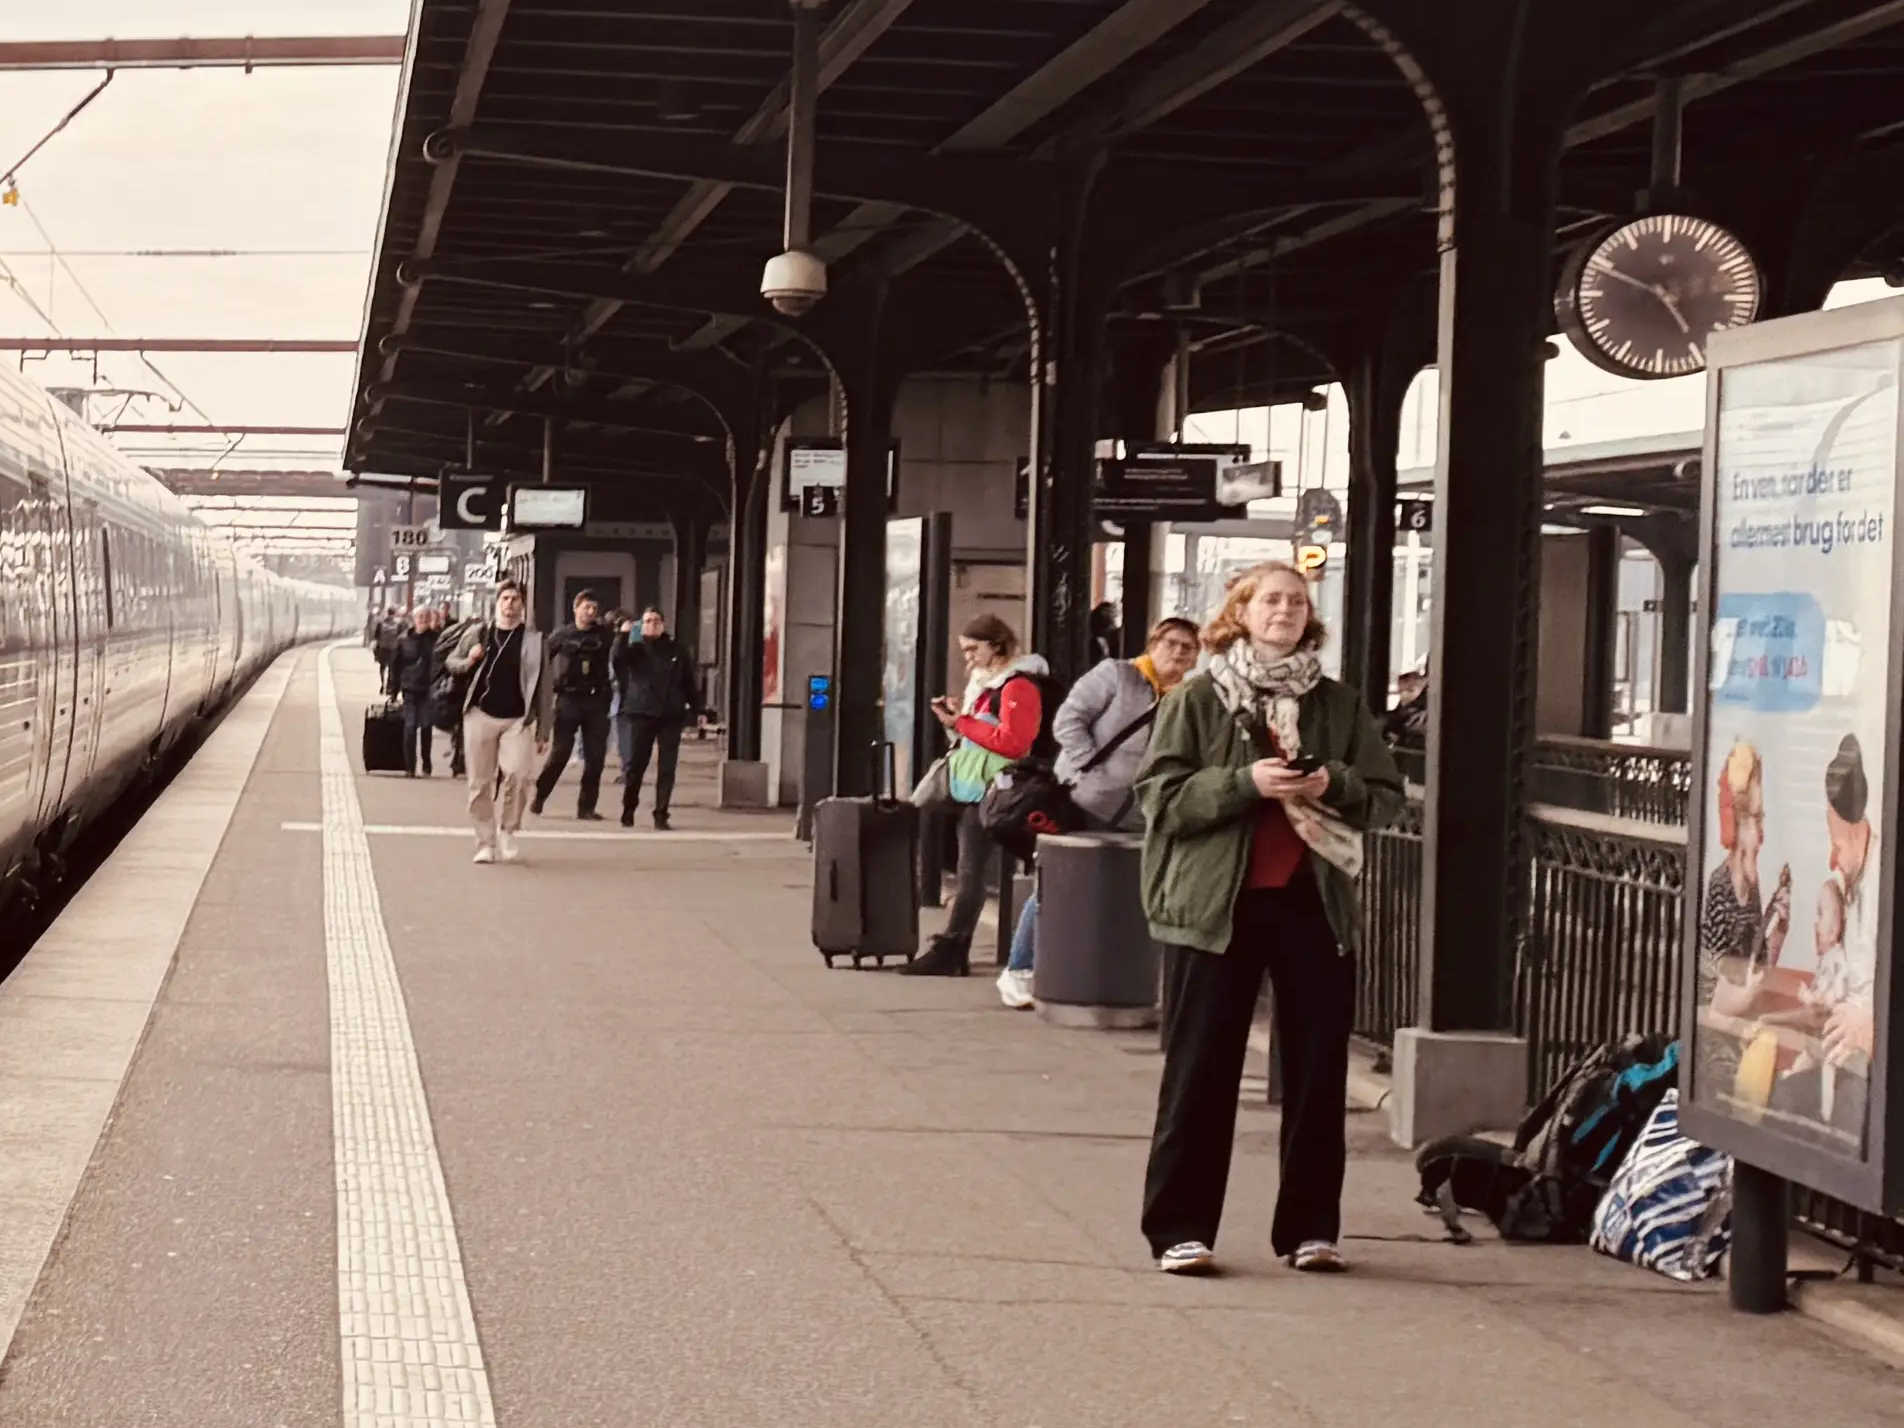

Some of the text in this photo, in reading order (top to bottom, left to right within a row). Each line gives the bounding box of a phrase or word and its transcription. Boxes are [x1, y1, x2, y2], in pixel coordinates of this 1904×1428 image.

[457, 486, 488, 524] C
[811, 496, 825, 515] 5
[1410, 510, 1426, 529] 6
[392, 529, 428, 547] 180
[1794, 514, 1833, 554] brug
[1837, 510, 1856, 544] for
[1857, 509, 1884, 543] det
[373, 569, 386, 584] A
